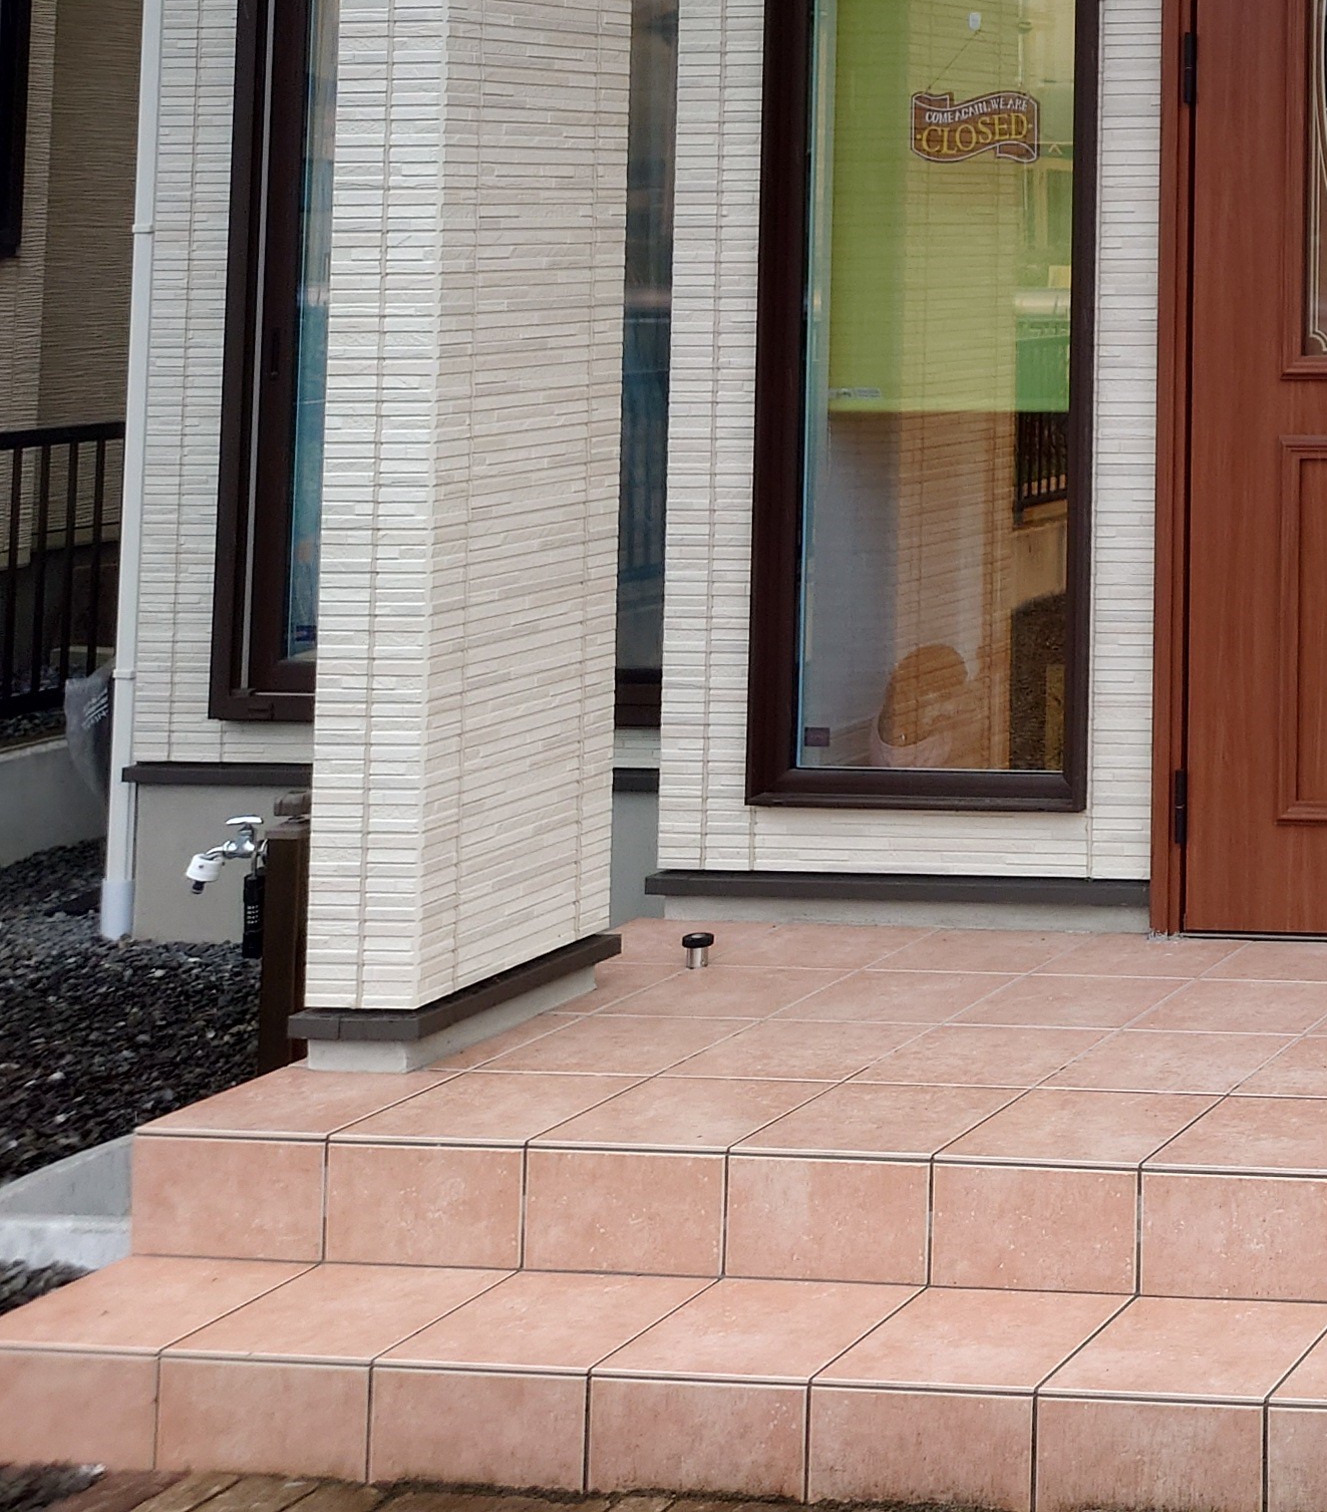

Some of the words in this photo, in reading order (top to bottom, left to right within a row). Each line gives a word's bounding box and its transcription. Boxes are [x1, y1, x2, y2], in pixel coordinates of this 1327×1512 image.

[925, 110, 953, 124] COME
[990, 97, 1006, 112] WE
[1007, 98, 1028, 112] ARE
[922, 112, 1027, 154] CLOSED
